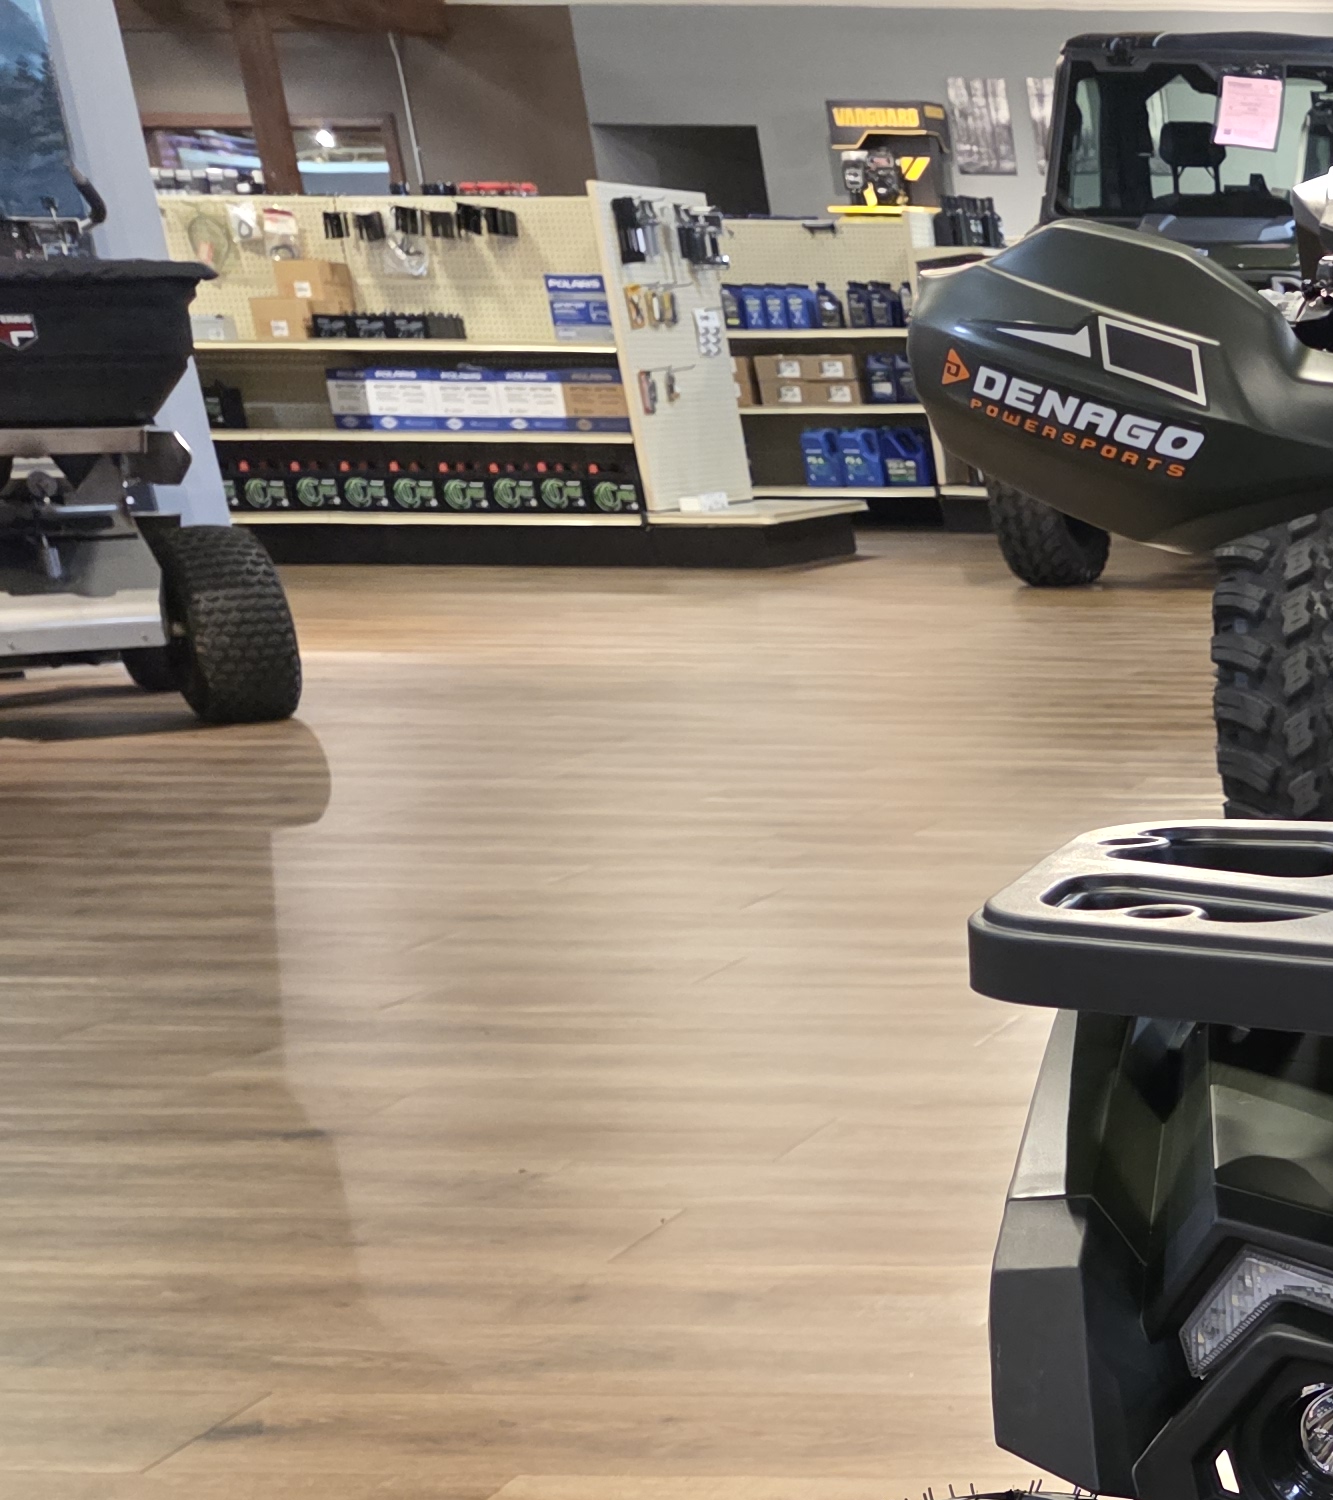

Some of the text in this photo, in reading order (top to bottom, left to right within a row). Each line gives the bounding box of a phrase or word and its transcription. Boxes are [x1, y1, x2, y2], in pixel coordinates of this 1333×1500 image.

[832, 107, 919, 127] VANGUARD
[969, 398, 1186, 478] POWERSPORTS
[972, 365, 1205, 461] DENAGO
